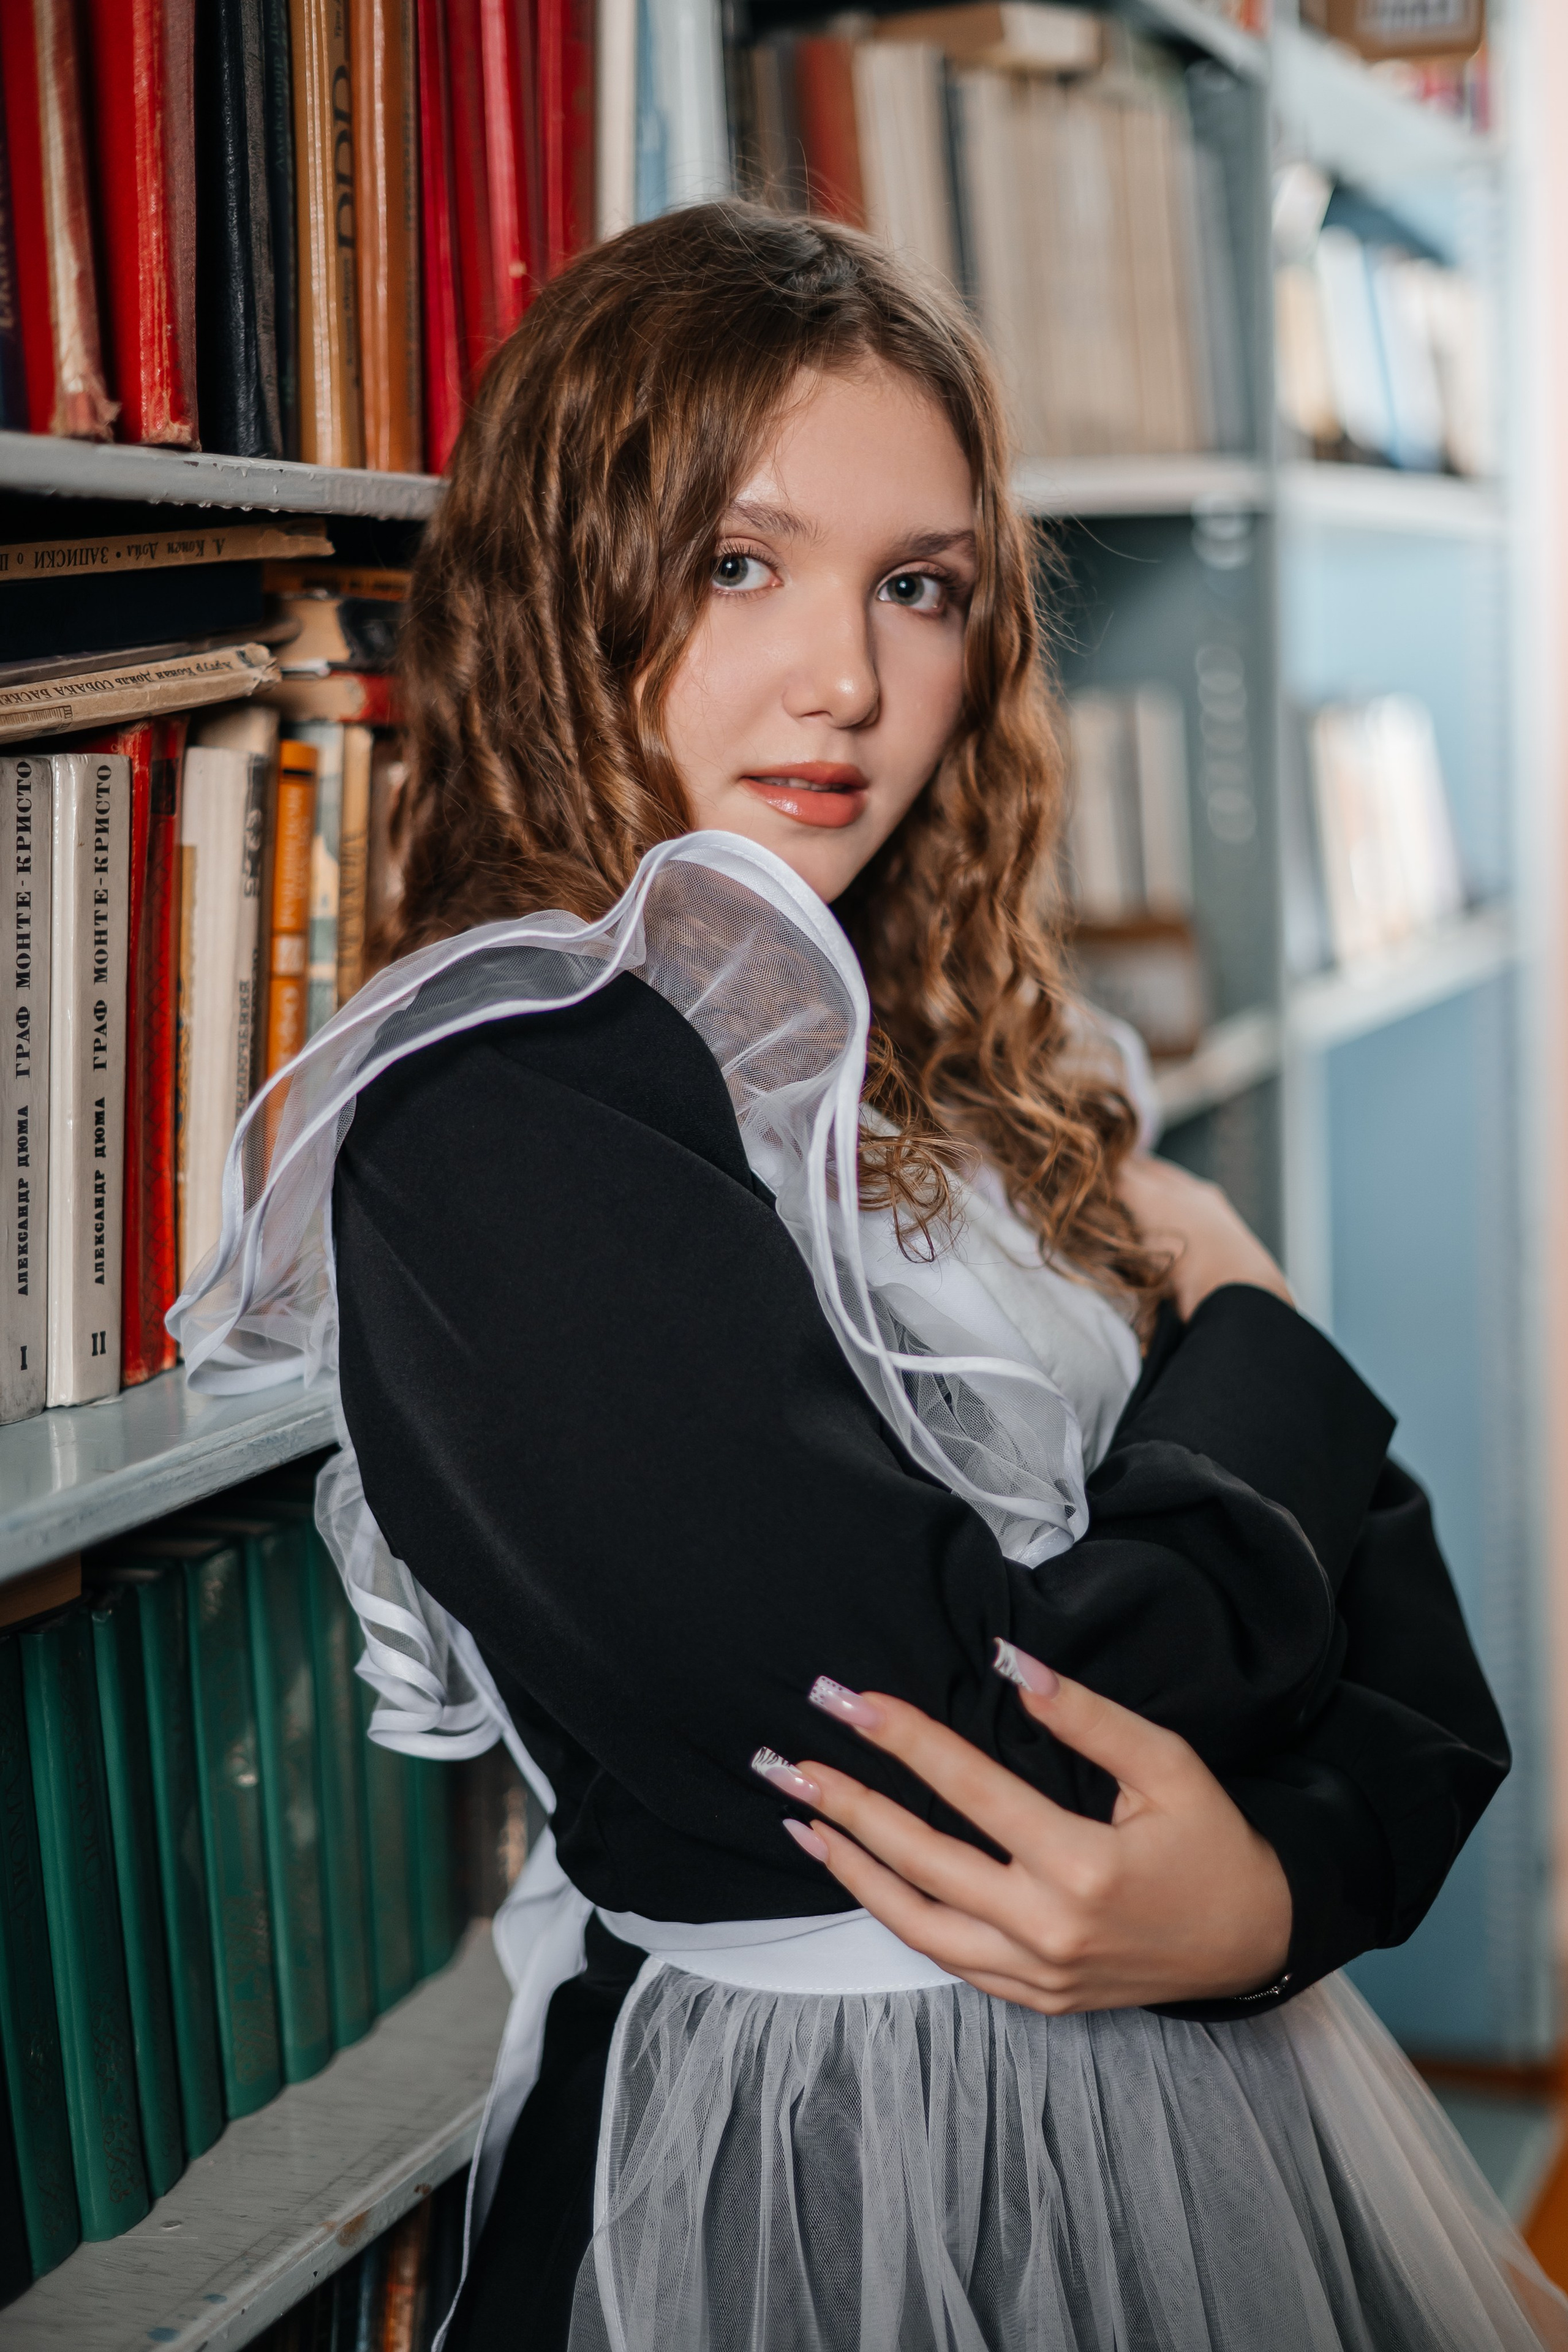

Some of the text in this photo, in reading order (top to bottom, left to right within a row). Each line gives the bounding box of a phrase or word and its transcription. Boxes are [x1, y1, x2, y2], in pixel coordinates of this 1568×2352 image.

[17, 552, 24, 565] о
[34, 546, 109, 569] ЗАПИСКИ
[155, 667, 197, 679] Конан
[53, 679, 115, 696] СОБАКА
[15, 1005, 31, 1079] ГРАФ
[93, 998, 108, 1072] ГРАФ
[17, 1104, 29, 1297] АЛЕКСАНДР ДЮМА
[94, 1096, 107, 1286] АЛЕКСАНДР ДЮМА
[91, 1330, 107, 1357] II
